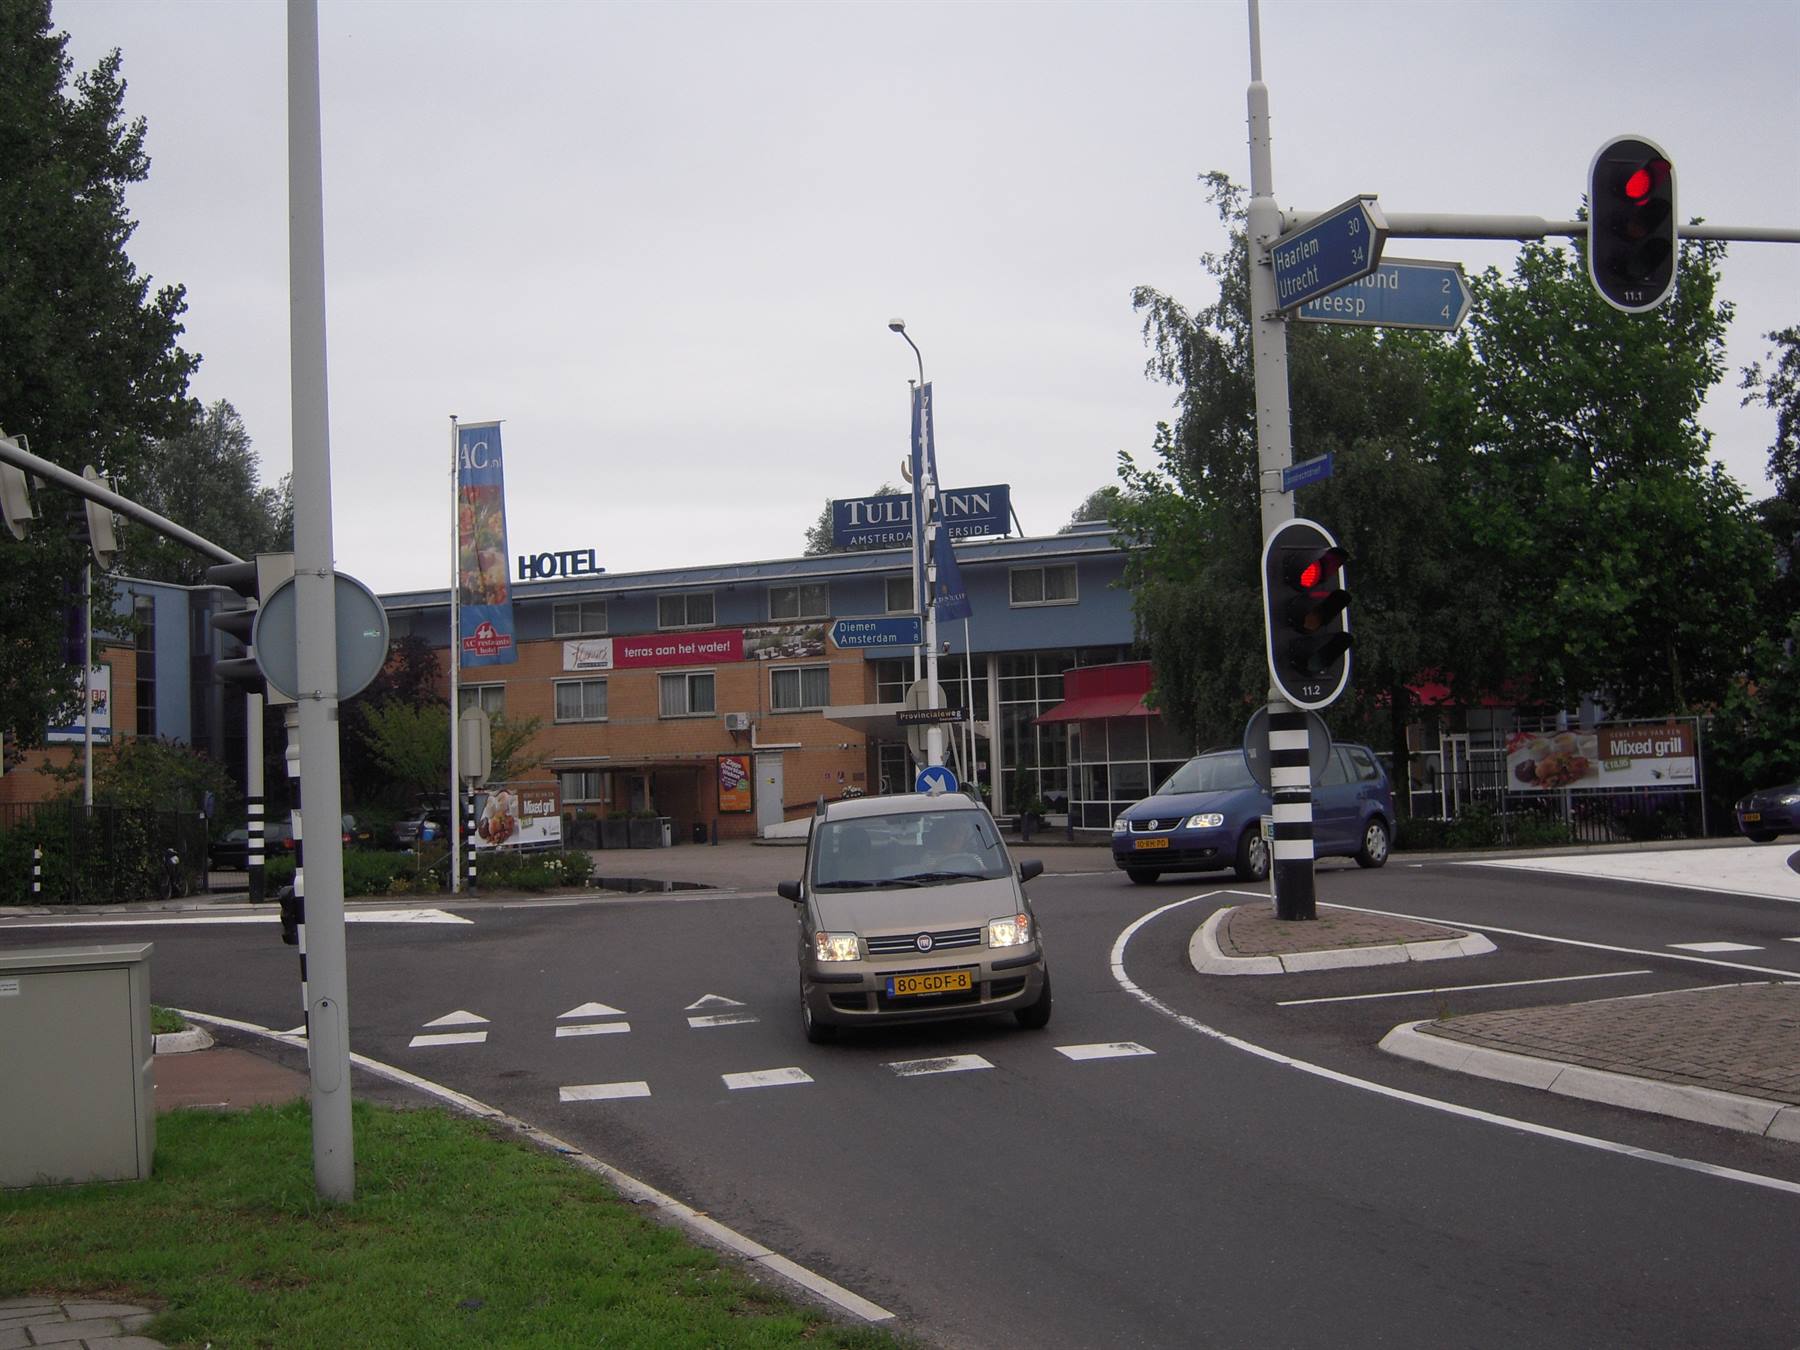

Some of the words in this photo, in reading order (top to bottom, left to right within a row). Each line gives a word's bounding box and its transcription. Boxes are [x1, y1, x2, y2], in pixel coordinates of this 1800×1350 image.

[1276, 238, 1320, 273] Haarlem
[1348, 217, 1360, 237] 30
[1280, 266, 1320, 299] Utrecht
[1351, 246, 1364, 265] 34
[1442, 278, 1450, 294] 2
[1624, 291, 1642, 301] 11.1
[1307, 297, 1366, 316] Weesp
[1440, 305, 1449, 320] 4
[845, 499, 913, 525] TULI
[850, 531, 912, 545] AMSTERDA
[518, 548, 606, 580] HOTEL
[840, 622, 876, 632] Diemen
[912, 621, 918, 630] 3
[840, 634, 897, 644] Amsterdam
[913, 633, 919, 641] 8
[625, 647, 653, 658] terras
[656, 648, 675, 656] aan
[679, 643, 695, 654] het
[698, 641, 731, 653] water!
[1302, 685, 1320, 696] 11.2
[1610, 739, 1652, 756] Mixed
[1655, 736, 1681, 756] grill
[523, 800, 542, 814] Mixed
[543, 799, 555, 816] grill
[898, 974, 967, 992] 80-GDF-8
